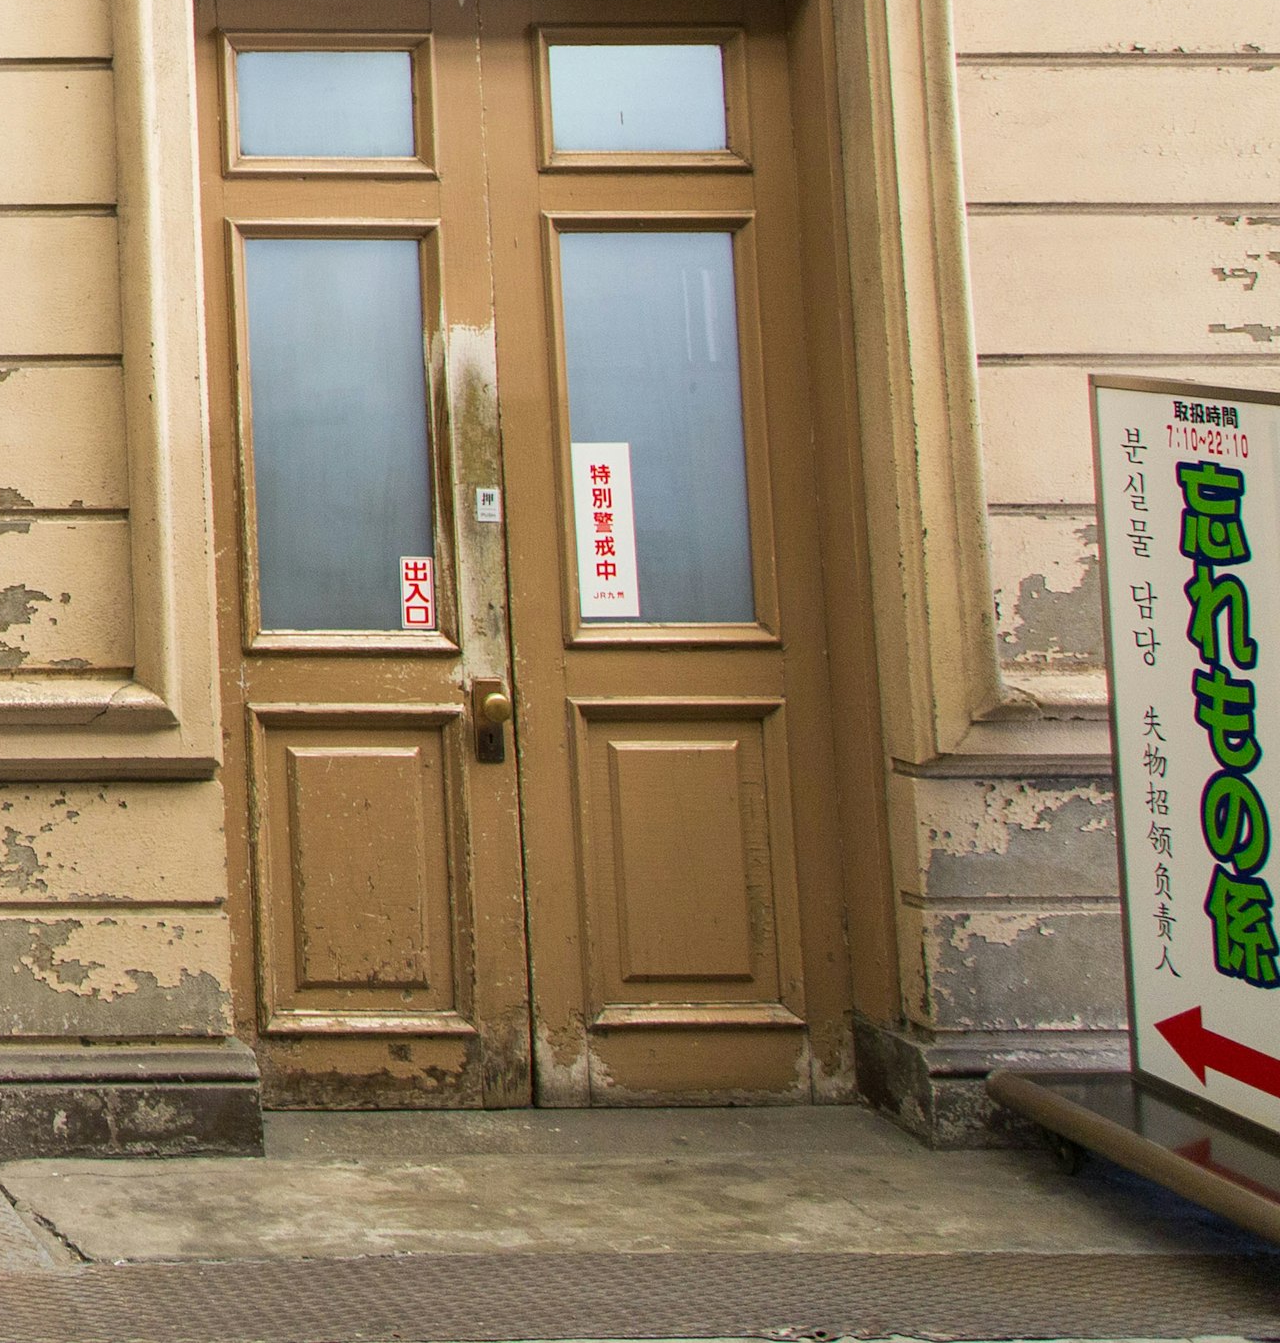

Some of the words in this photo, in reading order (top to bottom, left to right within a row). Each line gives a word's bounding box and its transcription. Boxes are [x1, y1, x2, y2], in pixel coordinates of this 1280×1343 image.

[1173, 400, 1239, 429] 取扱時間
[590, 464, 617, 581] 特別警戒中
[1120, 427, 1154, 558] 분실물
[404, 561, 430, 624] 出入口
[593, 591, 625, 599] JR九州
[1129, 580, 1161, 667] 담당
[1175, 460, 1280, 990] 忘れもの係
[1142, 705, 1182, 978] 失物招领负责人
